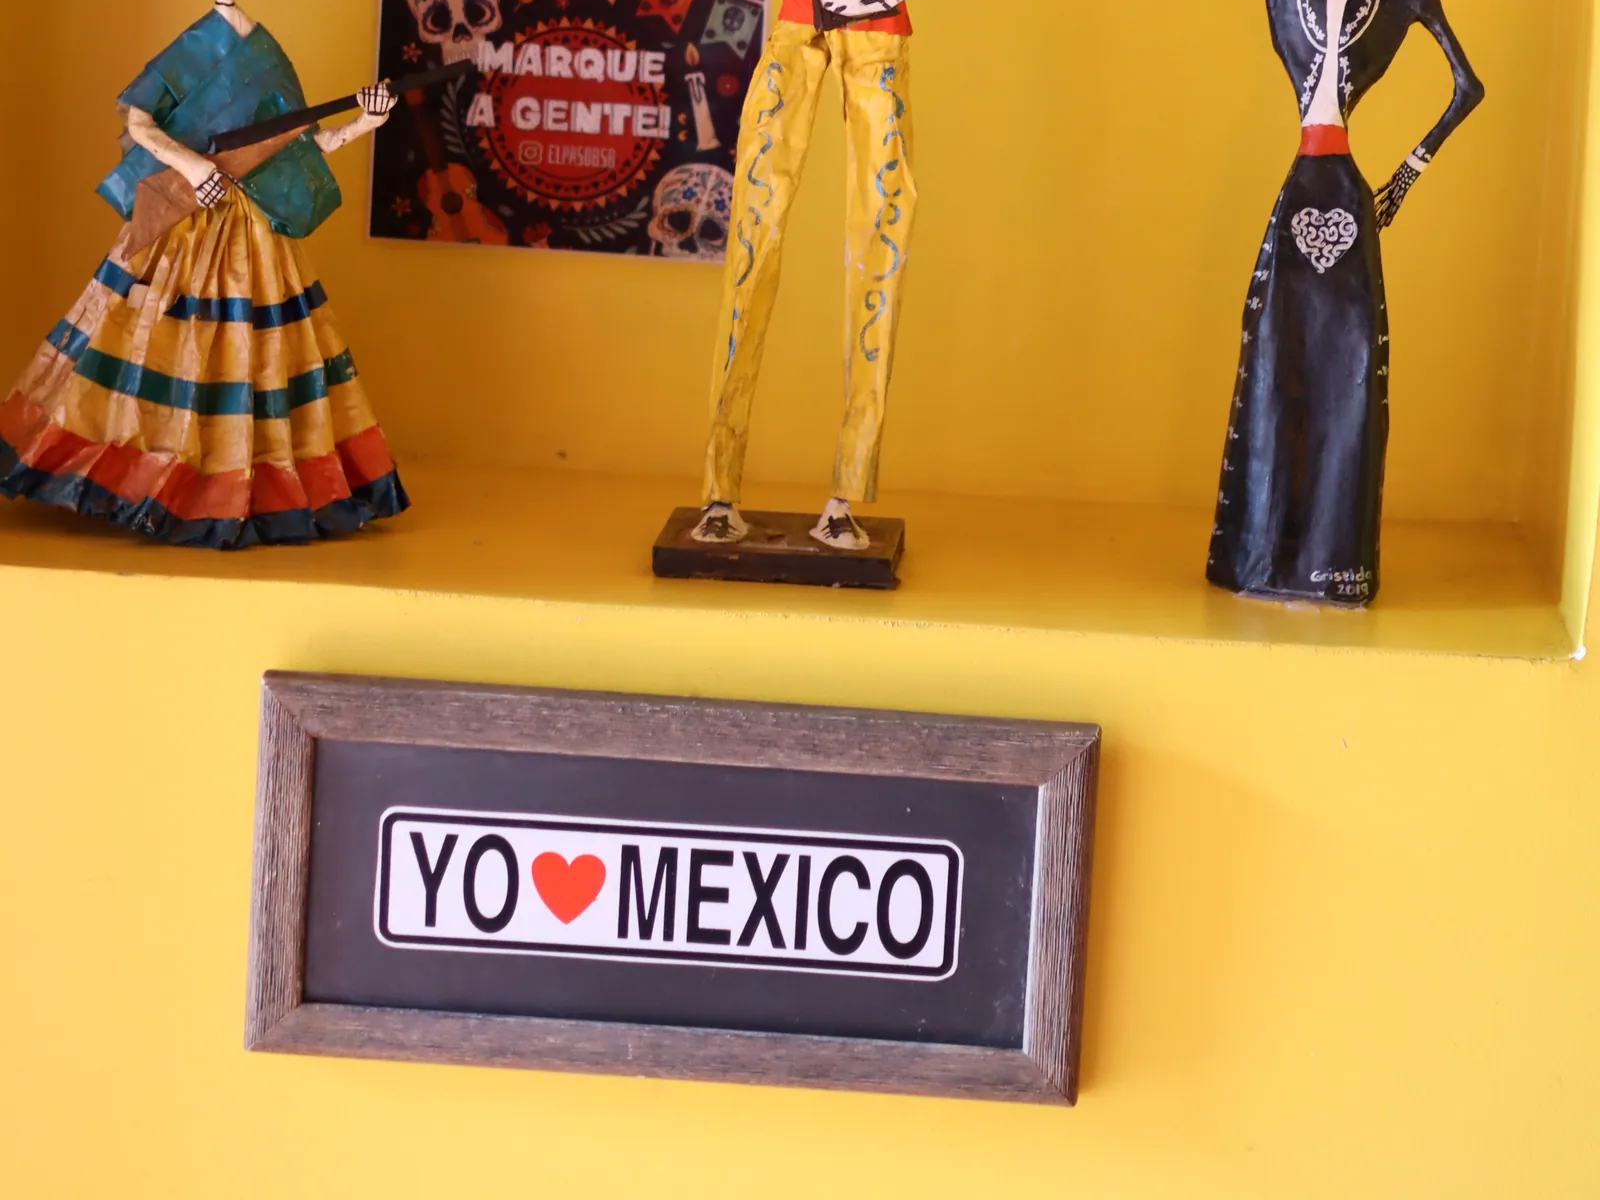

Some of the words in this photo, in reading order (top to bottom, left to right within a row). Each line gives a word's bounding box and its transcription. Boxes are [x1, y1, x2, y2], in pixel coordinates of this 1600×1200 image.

[475, 41, 667, 85] MARQUE
[466, 93, 496, 128] A
[511, 96, 671, 139] GENTE!
[1336, 582, 1369, 596] 2019
[408, 831, 520, 934] YO
[617, 843, 935, 960] MEXICO
